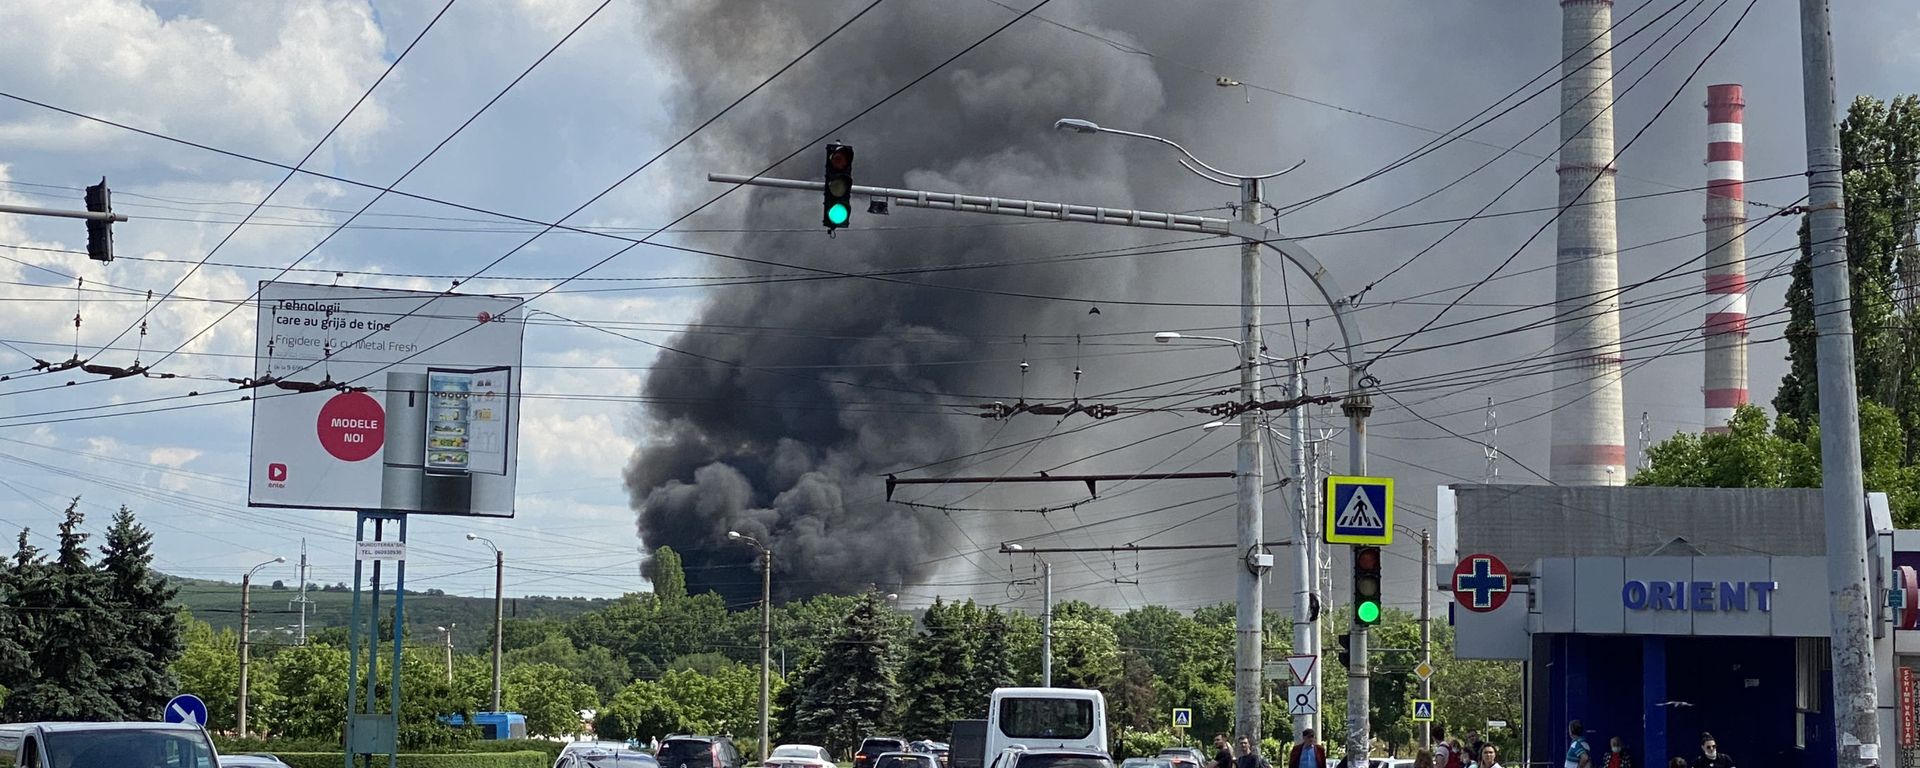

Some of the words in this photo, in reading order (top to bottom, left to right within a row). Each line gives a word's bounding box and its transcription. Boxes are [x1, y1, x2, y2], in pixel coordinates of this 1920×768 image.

[278, 300, 340, 315] Tehnologii
[276, 316, 301, 326] care
[303, 318, 318, 327] au
[349, 318, 364, 329] de
[367, 320, 391, 331] tine
[492, 314, 505, 323] LG
[275, 335, 320, 348] Frigidere
[355, 340, 386, 351] Metal
[388, 342, 418, 352] Fresh
[331, 418, 378, 429] MODELE
[344, 433, 364, 443] NOI
[1622, 580, 1778, 612] ORIENT
[1903, 669, 1911, 703] SCHIMB
[1904, 705, 1912, 744] VALUTAR
